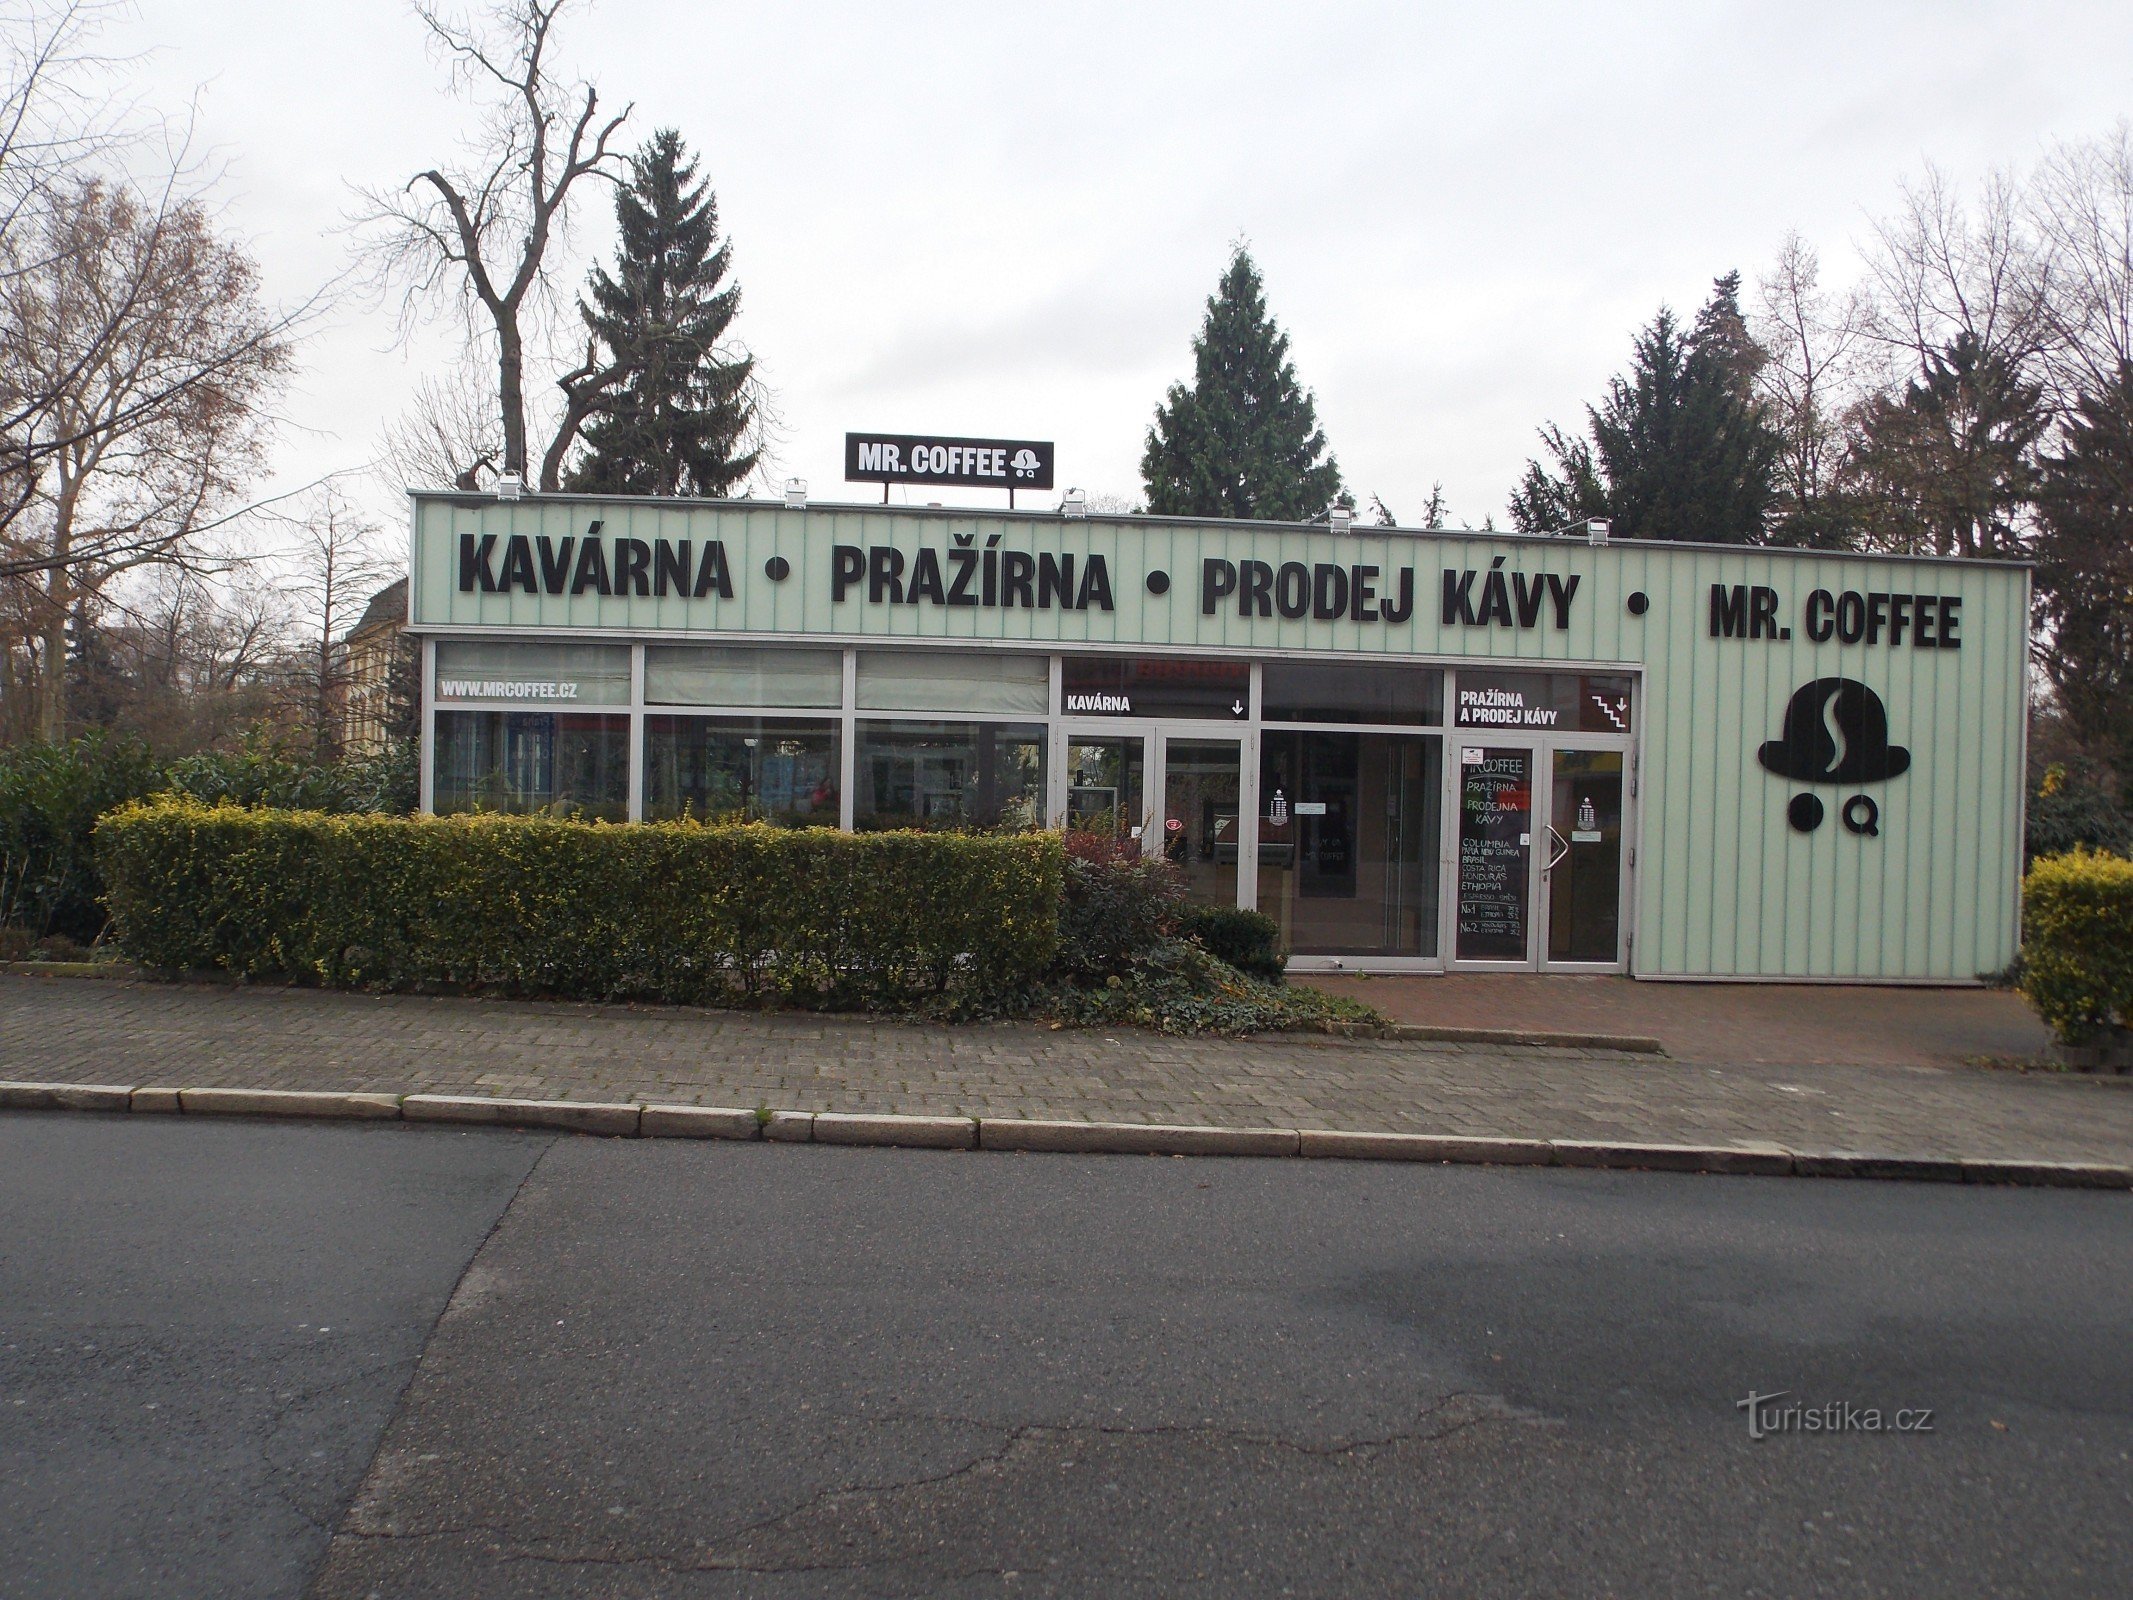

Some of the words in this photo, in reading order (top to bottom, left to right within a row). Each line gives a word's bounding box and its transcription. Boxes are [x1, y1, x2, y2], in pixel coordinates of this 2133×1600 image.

[858, 442, 908, 472] MR.
[911, 444, 1007, 477] COFFEE
[459, 520, 734, 599] KAVÁRNA
[831, 533, 1115, 611] PRAŽÍRNA
[1201, 557, 1414, 623] PRODEJ
[1441, 555, 1582, 630] KÁVY
[1709, 583, 1791, 640] MR.
[1805, 588, 1962, 648] COFFEE
[441, 680, 578, 698] WWW.MRCOFFEE.CZ
[1067, 692, 1130, 711] KAVÁRNA
[1460, 689, 1524, 708] PRAŽÍRNA
[1460, 707, 1470, 722] A
[1472, 708, 1521, 724] PRODEJ
[1523, 706, 1558, 725] KÁVY
[1483, 758, 1524, 774] COFFEE
[1466, 780, 1517, 792] PRAŽÍRNA
[1467, 799, 1519, 812] PRODEJNA
[1475, 811, 1504, 825] KÁVY
[1462, 837, 1511, 849] COLUMBIA
[1461, 855, 1488, 865] BRASIL
[1495, 848, 1520, 858] GUINEA
[1461, 863, 1486, 872] COSTA
[1488, 864, 1507, 872] RICA
[1461, 871, 1508, 881] HONDURAS
[1461, 881, 1502, 891] ETHIOPIA
[1460, 921, 1480, 933] No.2
